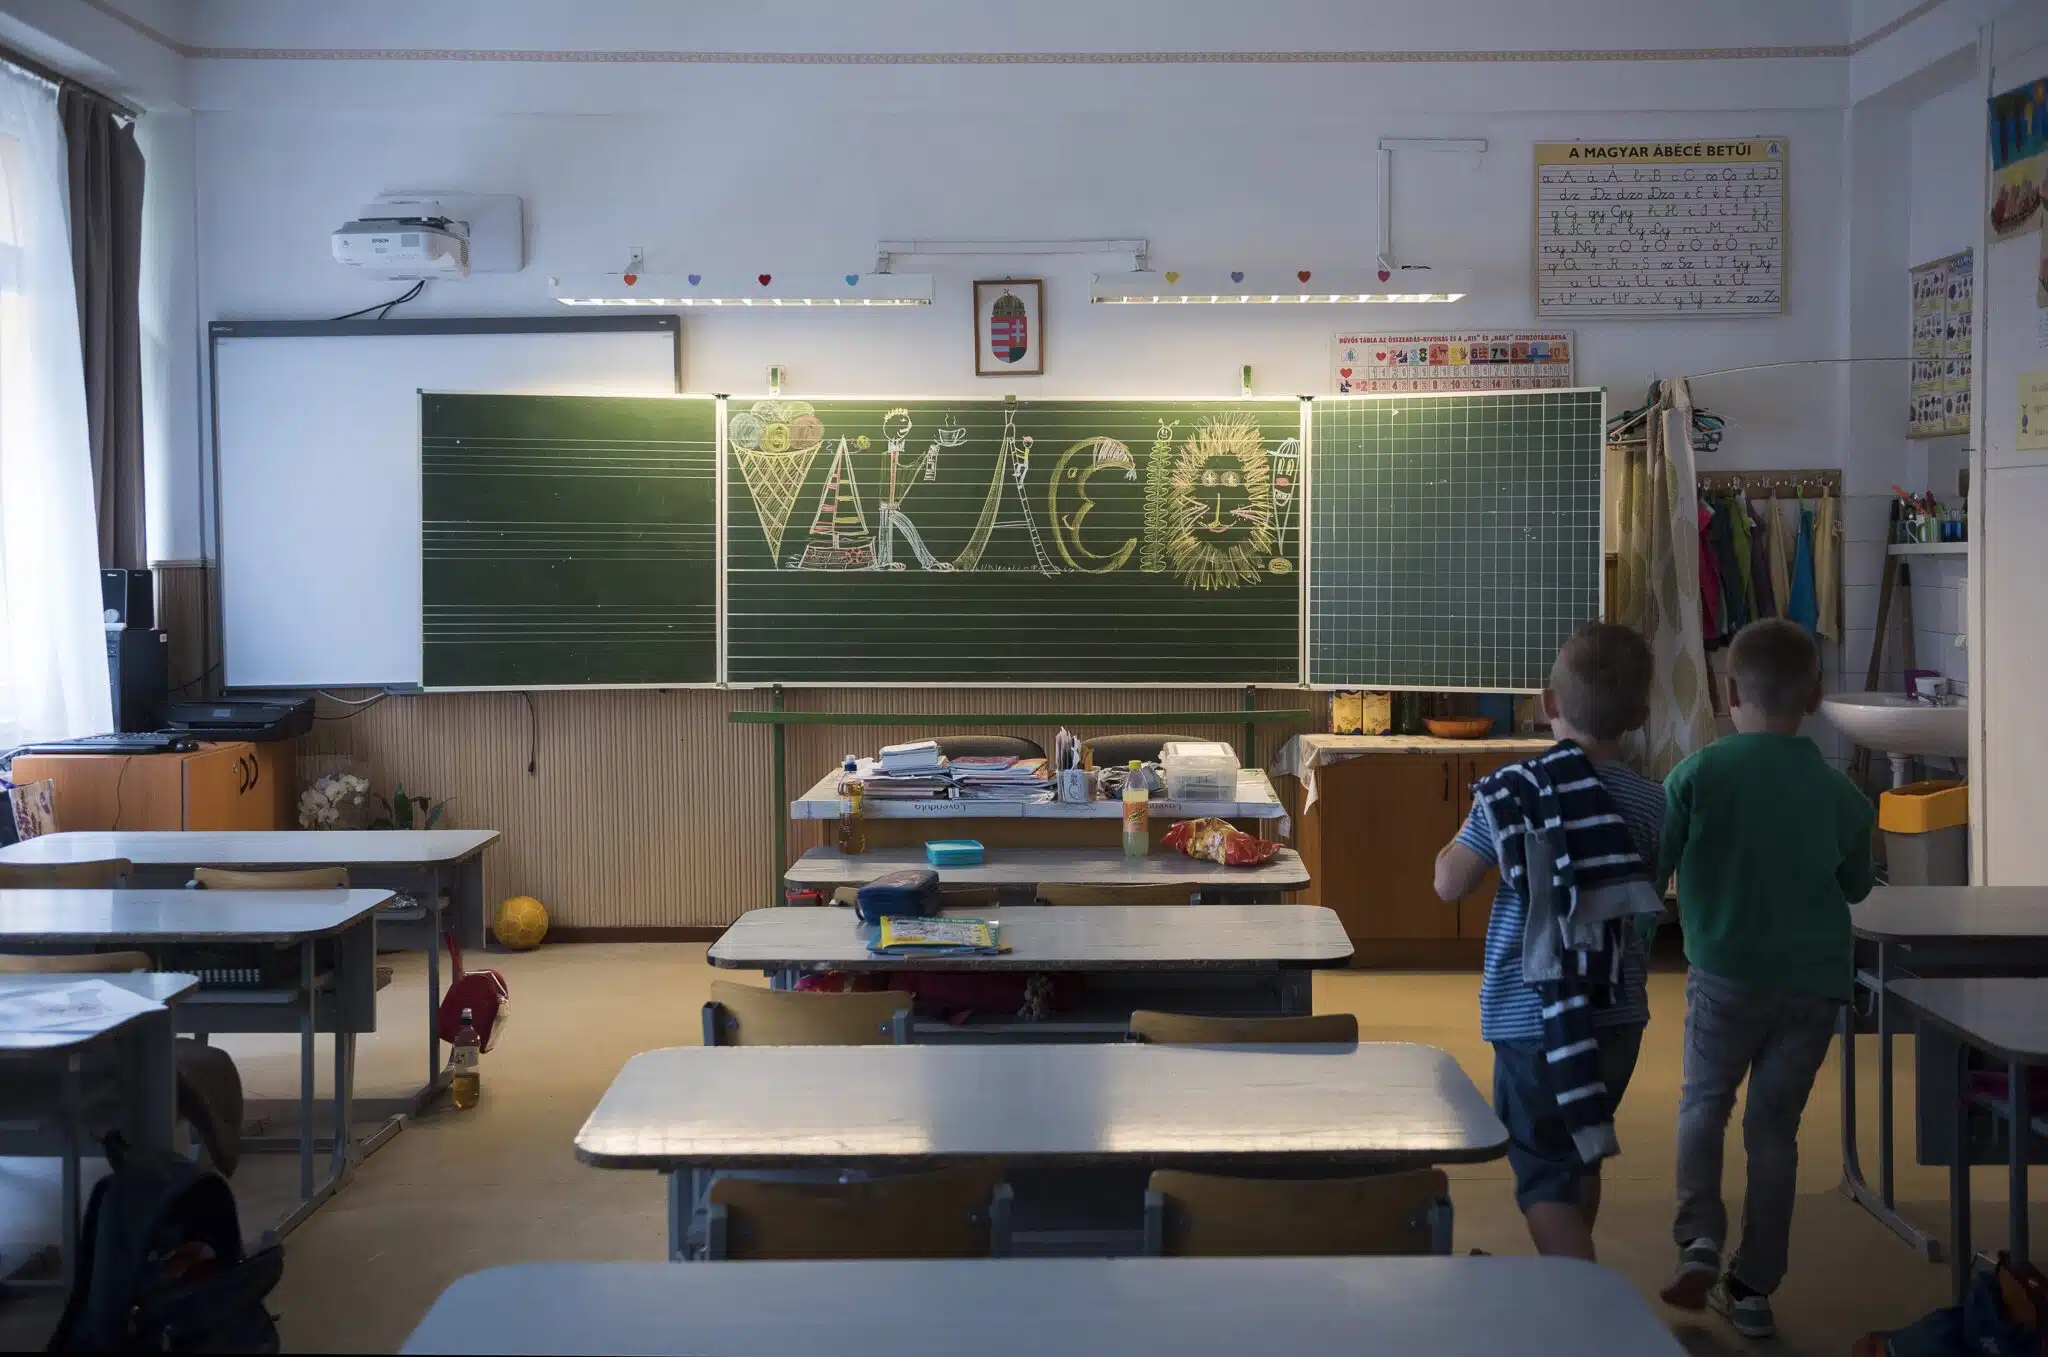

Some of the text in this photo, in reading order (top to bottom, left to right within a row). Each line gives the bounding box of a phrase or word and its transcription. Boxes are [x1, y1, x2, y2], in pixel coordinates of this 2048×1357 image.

[1568, 147, 1580, 158] A
[1584, 146, 1648, 158] MAGYAR
[1652, 142, 1702, 158] ÁBÉCÉ
[914, 804, 966, 812] Lavendula
